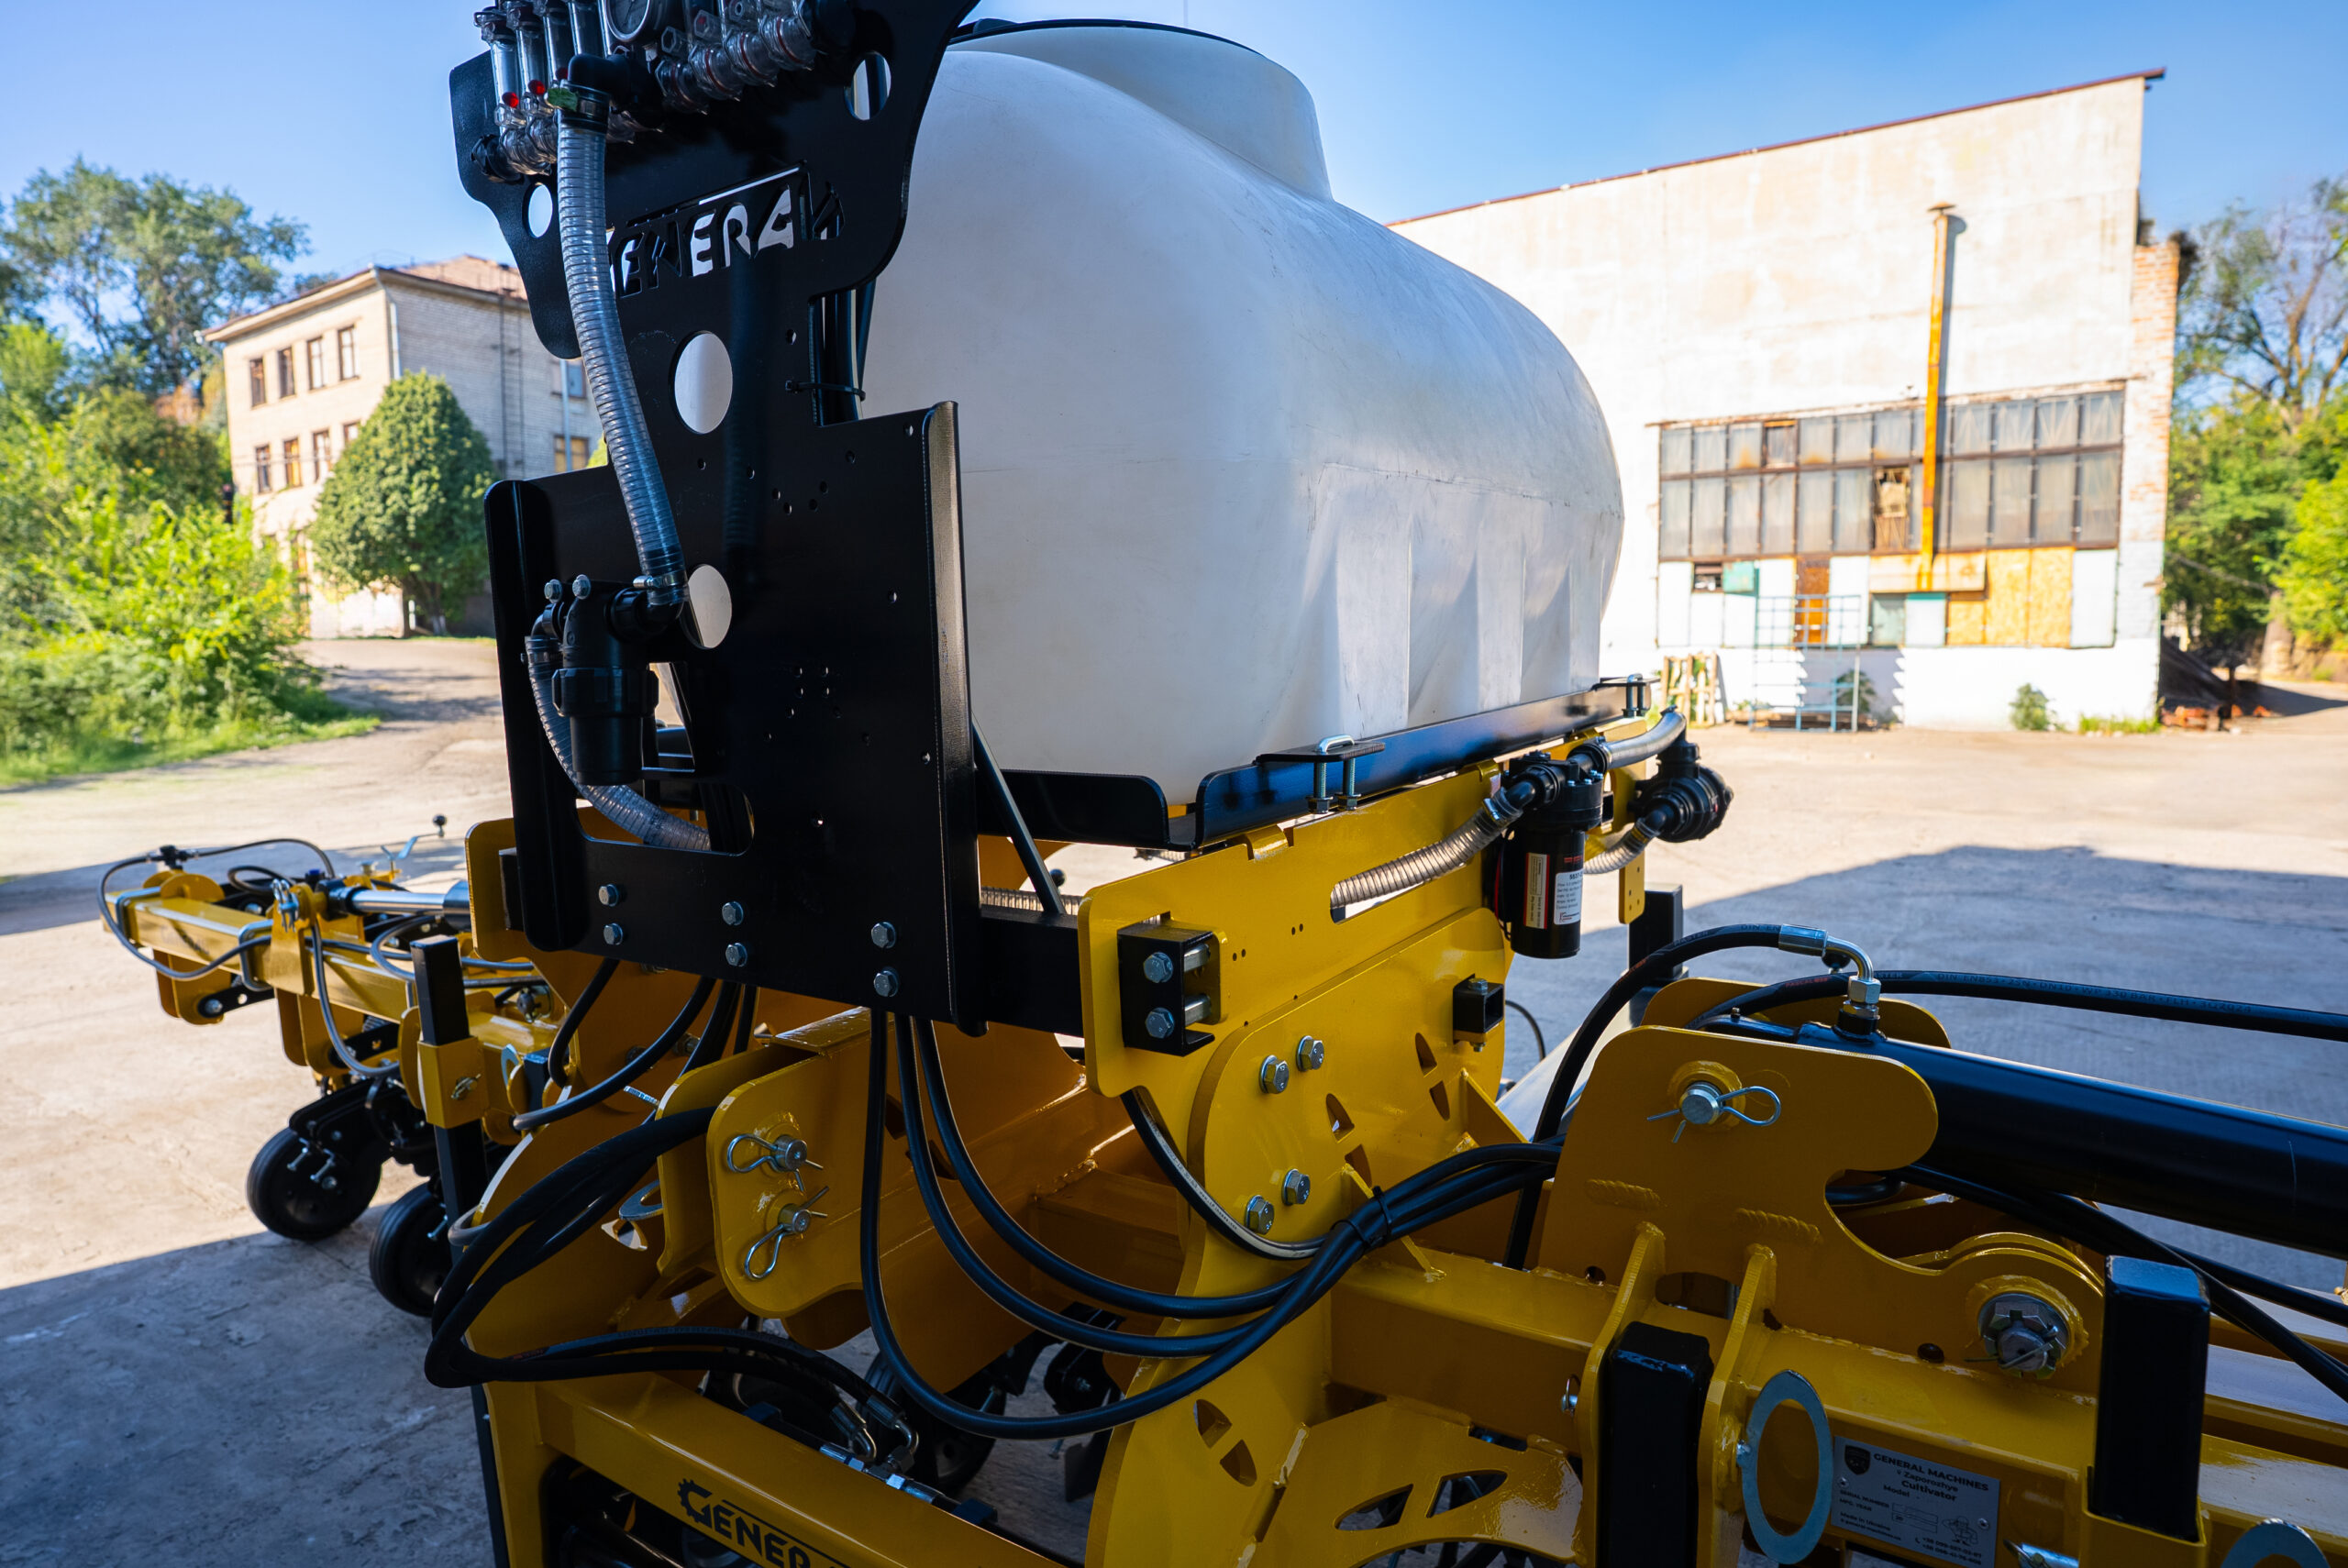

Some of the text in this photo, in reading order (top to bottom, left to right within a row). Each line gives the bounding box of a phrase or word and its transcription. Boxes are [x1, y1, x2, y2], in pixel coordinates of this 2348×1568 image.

[1937, 973, 1957, 981] DIN
[2129, 991, 2155, 1001] BAR
[1873, 1452, 1924, 1474] GENERAL
[1927, 1468, 1988, 1490] MACHINES
[1903, 1471, 1958, 1491] Zaporozhye
[1883, 1484, 1910, 1496] Model
[1900, 1480, 1956, 1501] Cultivator
[677, 1478, 833, 1568] GENER
[1840, 1511, 1857, 1520] Made
